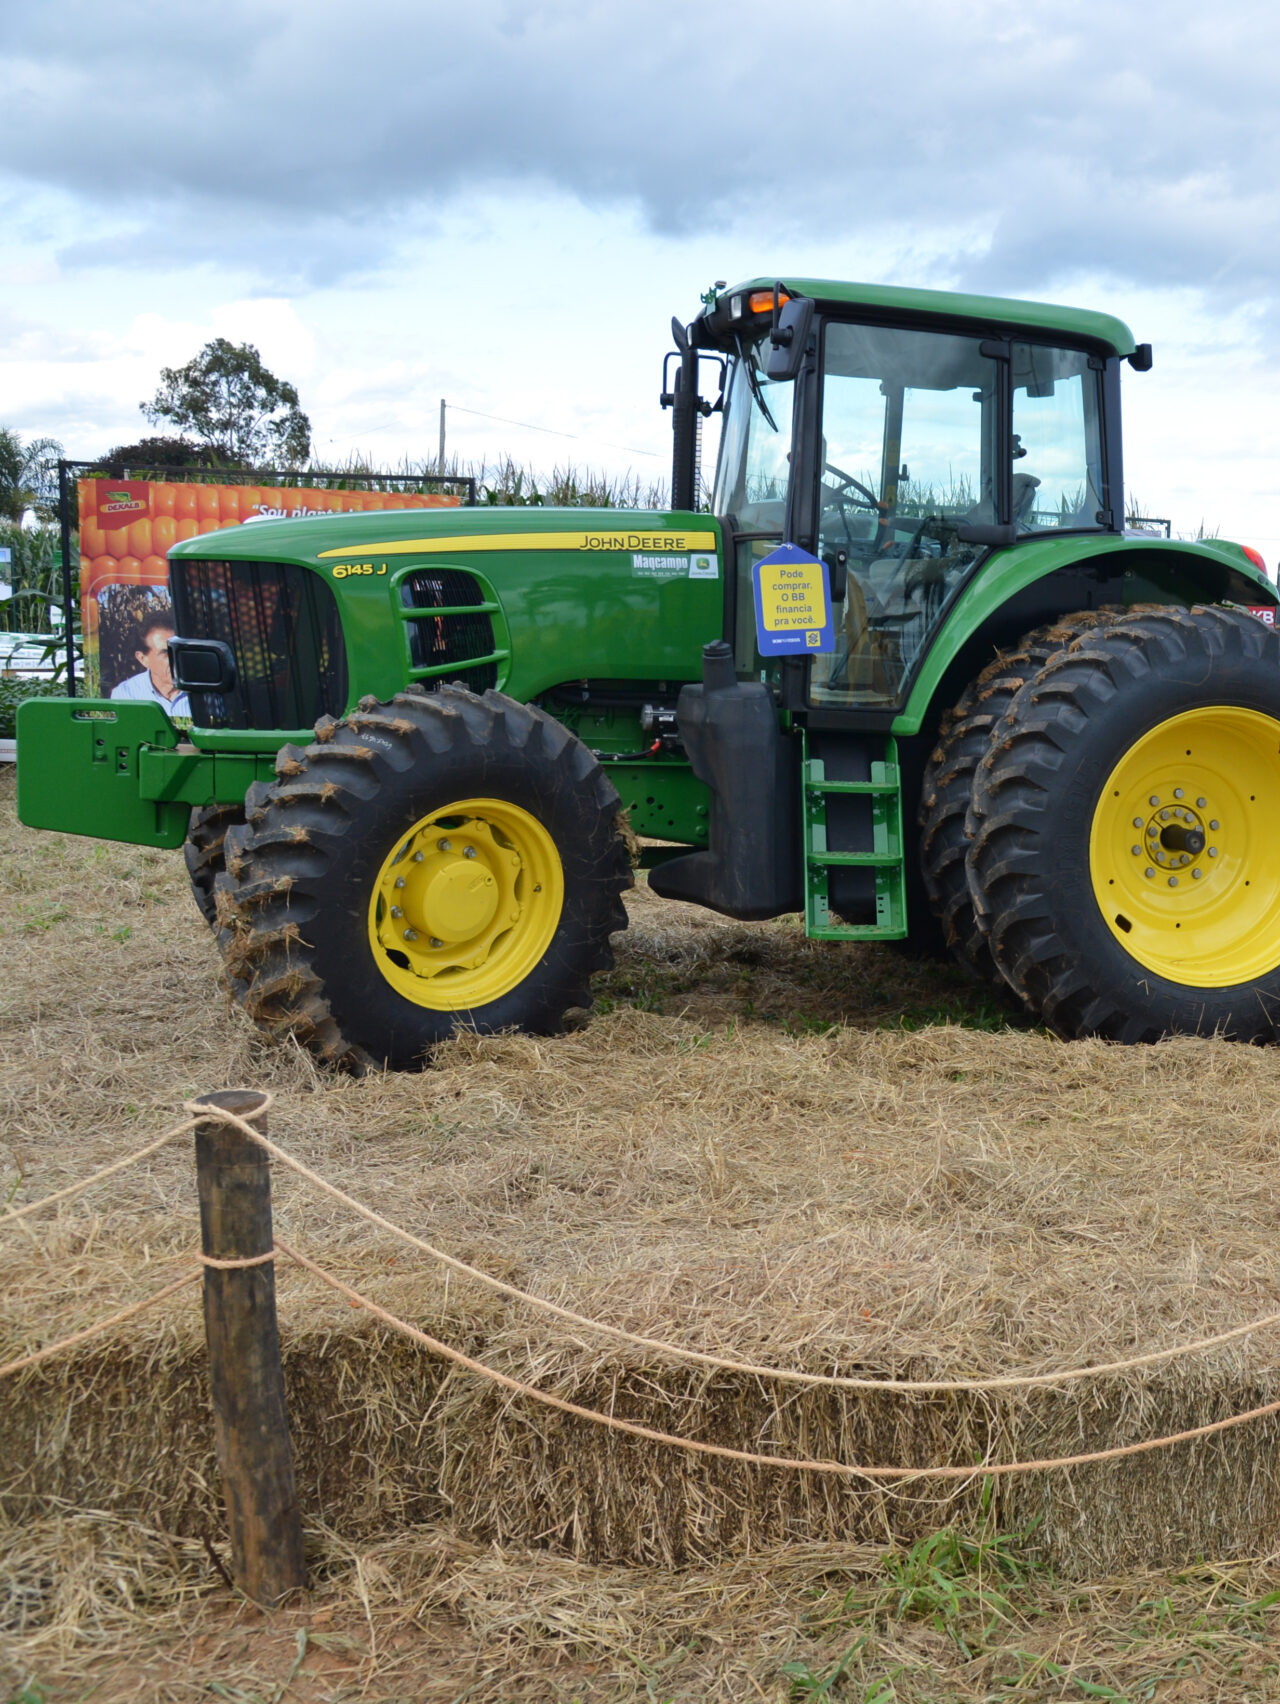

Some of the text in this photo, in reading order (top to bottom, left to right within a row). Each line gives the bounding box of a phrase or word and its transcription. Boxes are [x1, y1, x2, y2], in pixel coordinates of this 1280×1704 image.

[580, 535, 686, 549] JOHN DEERE
[332, 563, 387, 579] 6145 J
[780, 570, 804, 579] Pode
[772, 582, 813, 591] comprar.
[781, 593, 805, 602] O BB
[776, 605, 812, 614] financia
[774, 618, 789, 627] pra
